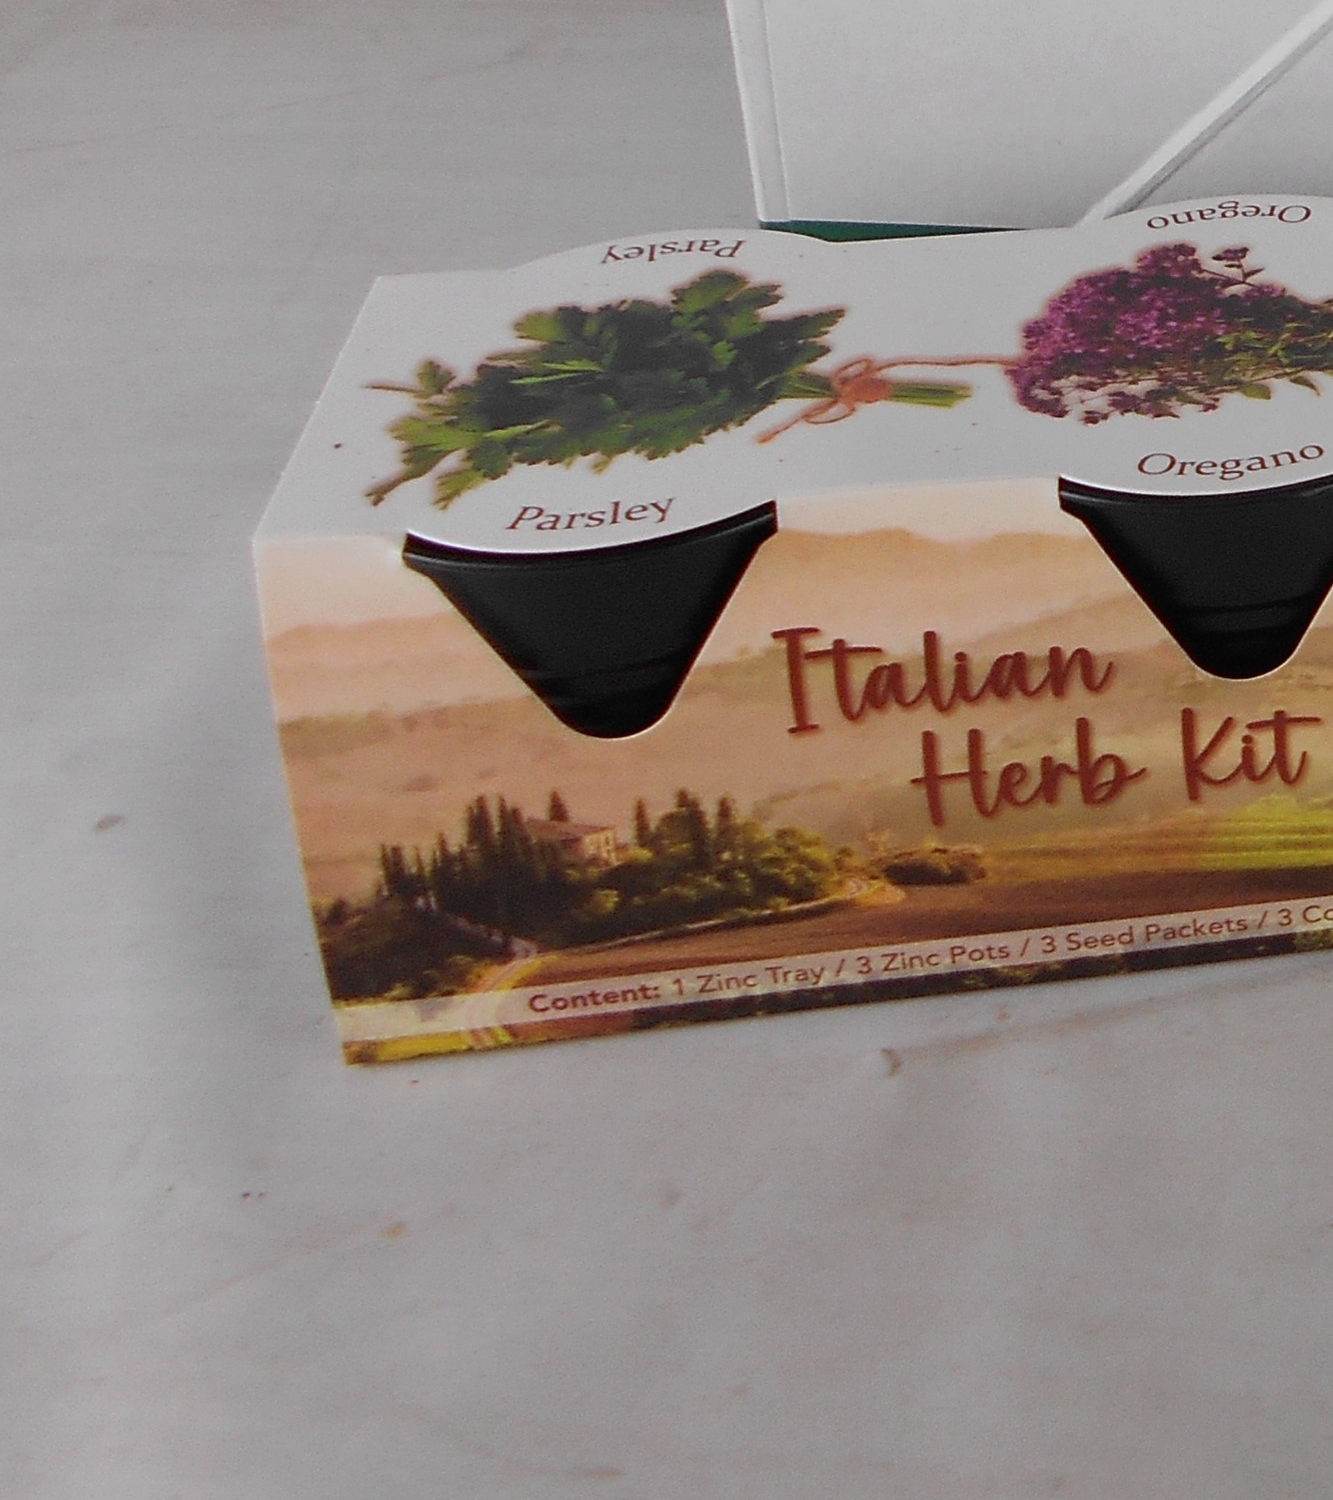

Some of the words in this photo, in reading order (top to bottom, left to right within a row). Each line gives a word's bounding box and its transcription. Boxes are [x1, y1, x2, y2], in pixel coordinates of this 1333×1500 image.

[1146, 204, 1313, 232] Oregano
[601, 237, 747, 265] Parsley
[1137, 440, 1326, 482] Oregano
[505, 497, 677, 535] Parsley
[771, 625, 1117, 737] Italian
[909, 714, 1149, 829] Herb
[1180, 706, 1322, 804] Kit
[527, 983, 664, 1015] Content:
[672, 976, 686, 999] 1
[696, 967, 758, 996] Zinc
[765, 960, 825, 991] Tray
[855, 953, 873, 975] 3
[880, 943, 941, 973] Zinc
[949, 937, 1011, 965] Pots
[1040, 930, 1058, 953] 3
[1065, 923, 1137, 951] Seed
[1144, 911, 1249, 944] Packets
[1277, 906, 1293, 928] 3
